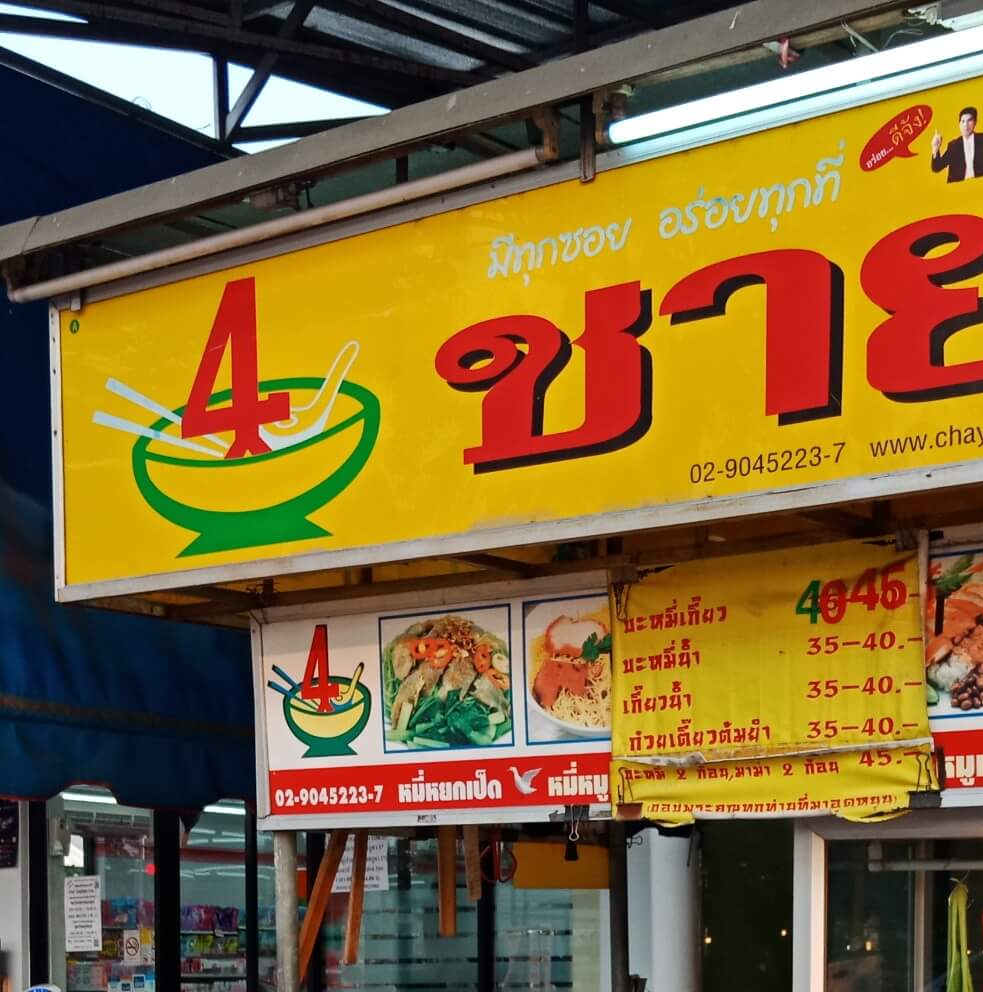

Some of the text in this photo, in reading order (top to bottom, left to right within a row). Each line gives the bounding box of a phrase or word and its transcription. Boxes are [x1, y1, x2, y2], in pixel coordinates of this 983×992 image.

[487, 140, 847, 286] มีทุกซอย อร่อยทุกที่
[690, 441, 847, 484] 02-9045223-7
[623, 596, 728, 634] บะหมี่เกี๊ยว
[622, 638, 701, 674] บะหมี่น้ำ
[622, 681, 692, 715] เกี๊ยวน้ำ
[274, 784, 384, 808] 02-9045223-7
[398, 769, 502, 803] หมี่หยกเป็ด
[676, 768, 687, 781] 2
[782, 762, 793, 776] 2
